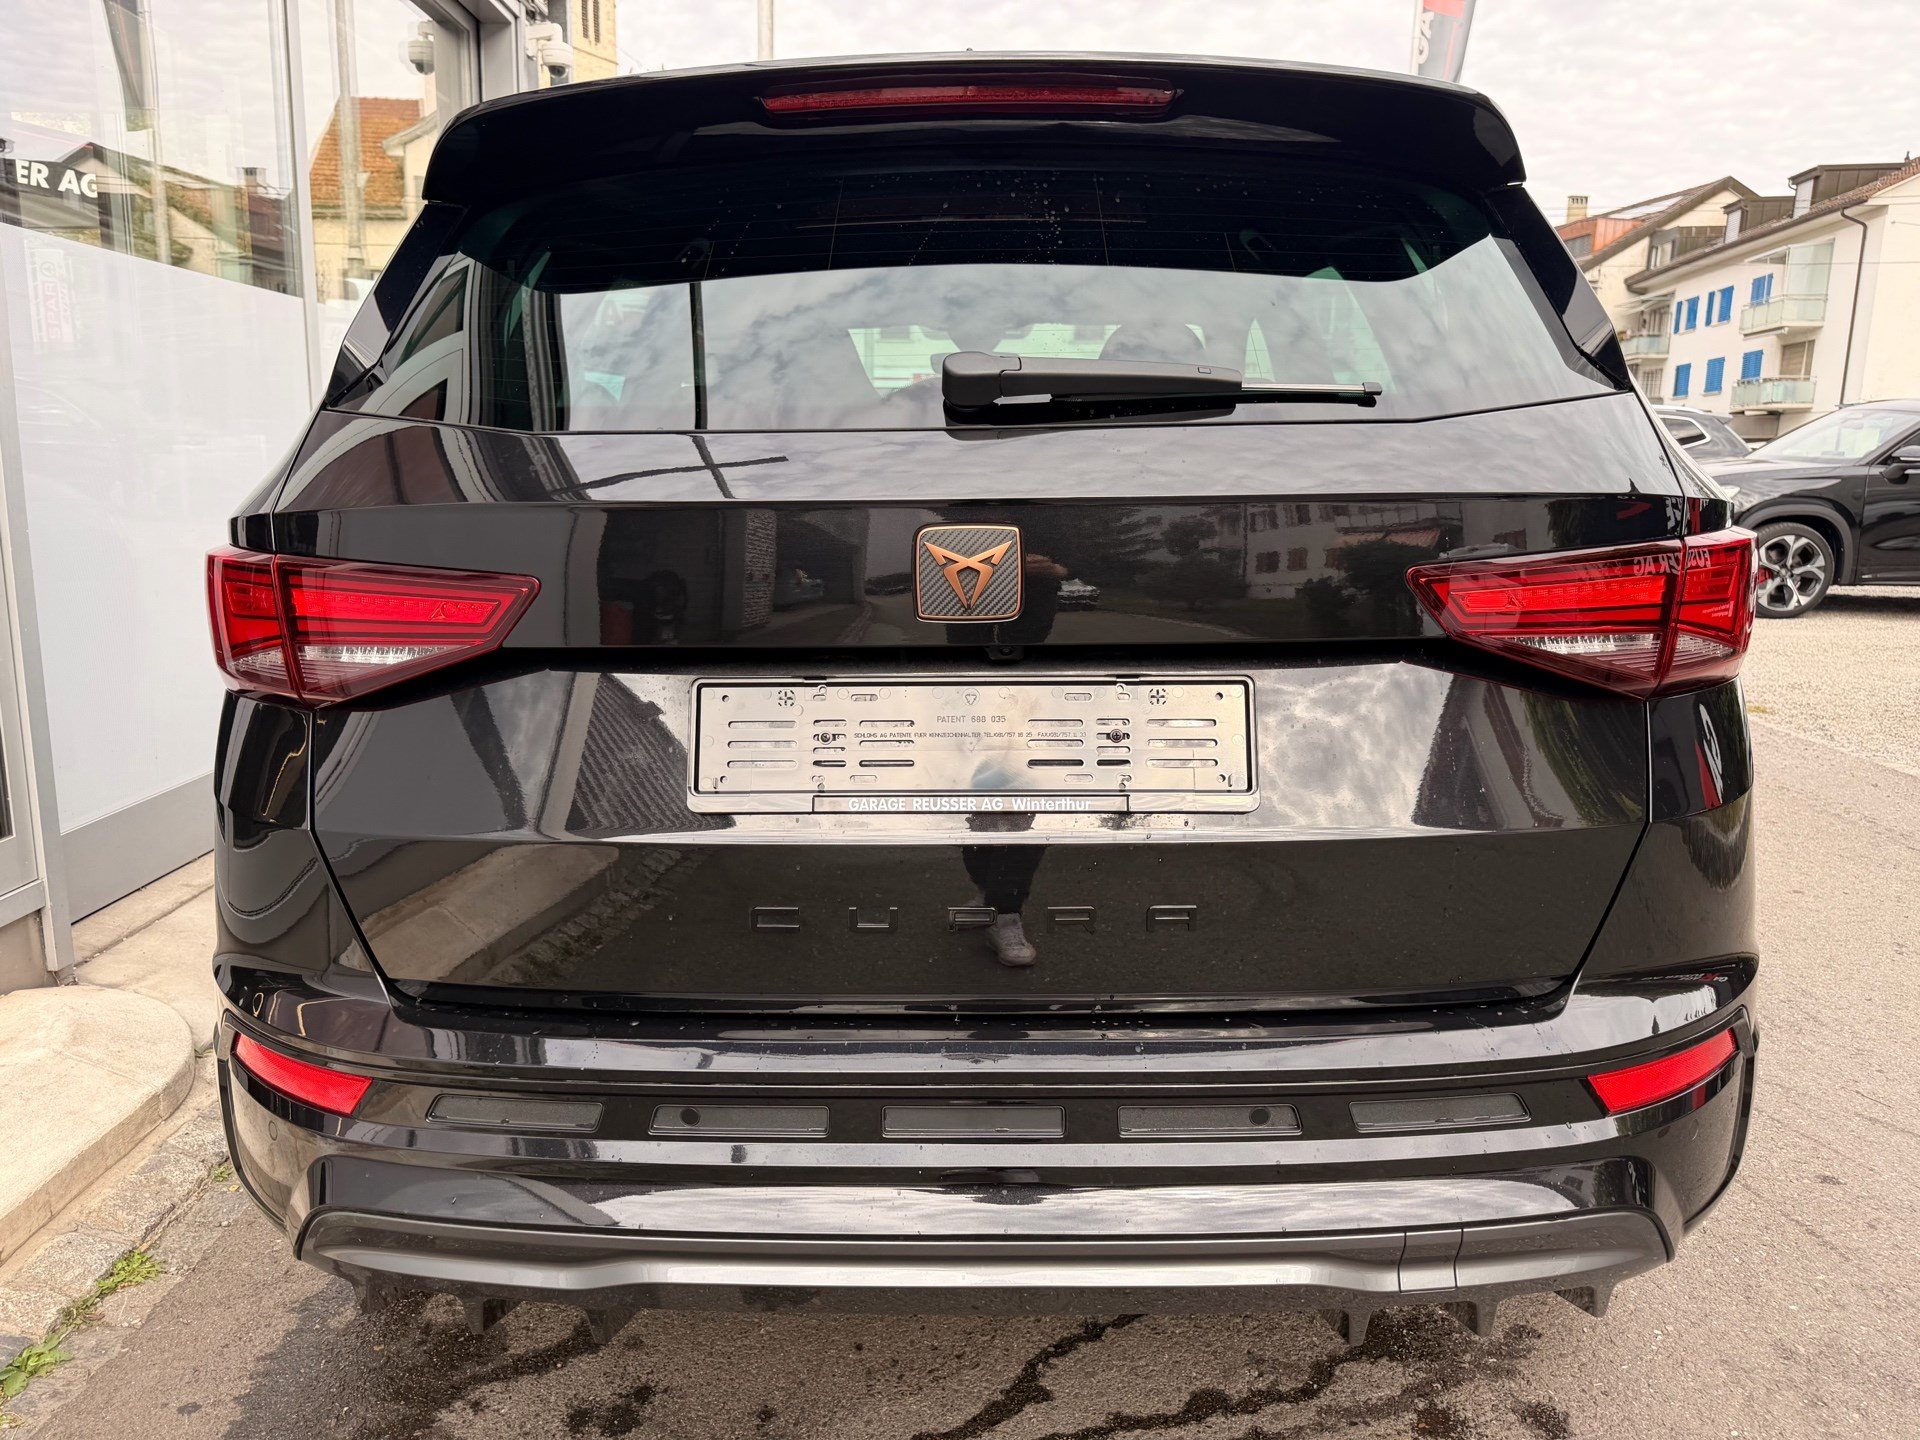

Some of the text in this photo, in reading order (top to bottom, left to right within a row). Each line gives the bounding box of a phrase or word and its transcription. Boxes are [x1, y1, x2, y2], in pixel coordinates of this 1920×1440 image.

[58, 169, 98, 198] AG
[936, 715, 966, 724] PATENT
[991, 715, 1007, 723] 035
[848, 797, 1091, 812] GARAGE REUSSER AG Winterthur
[749, 905, 1197, 934] CUPRA
